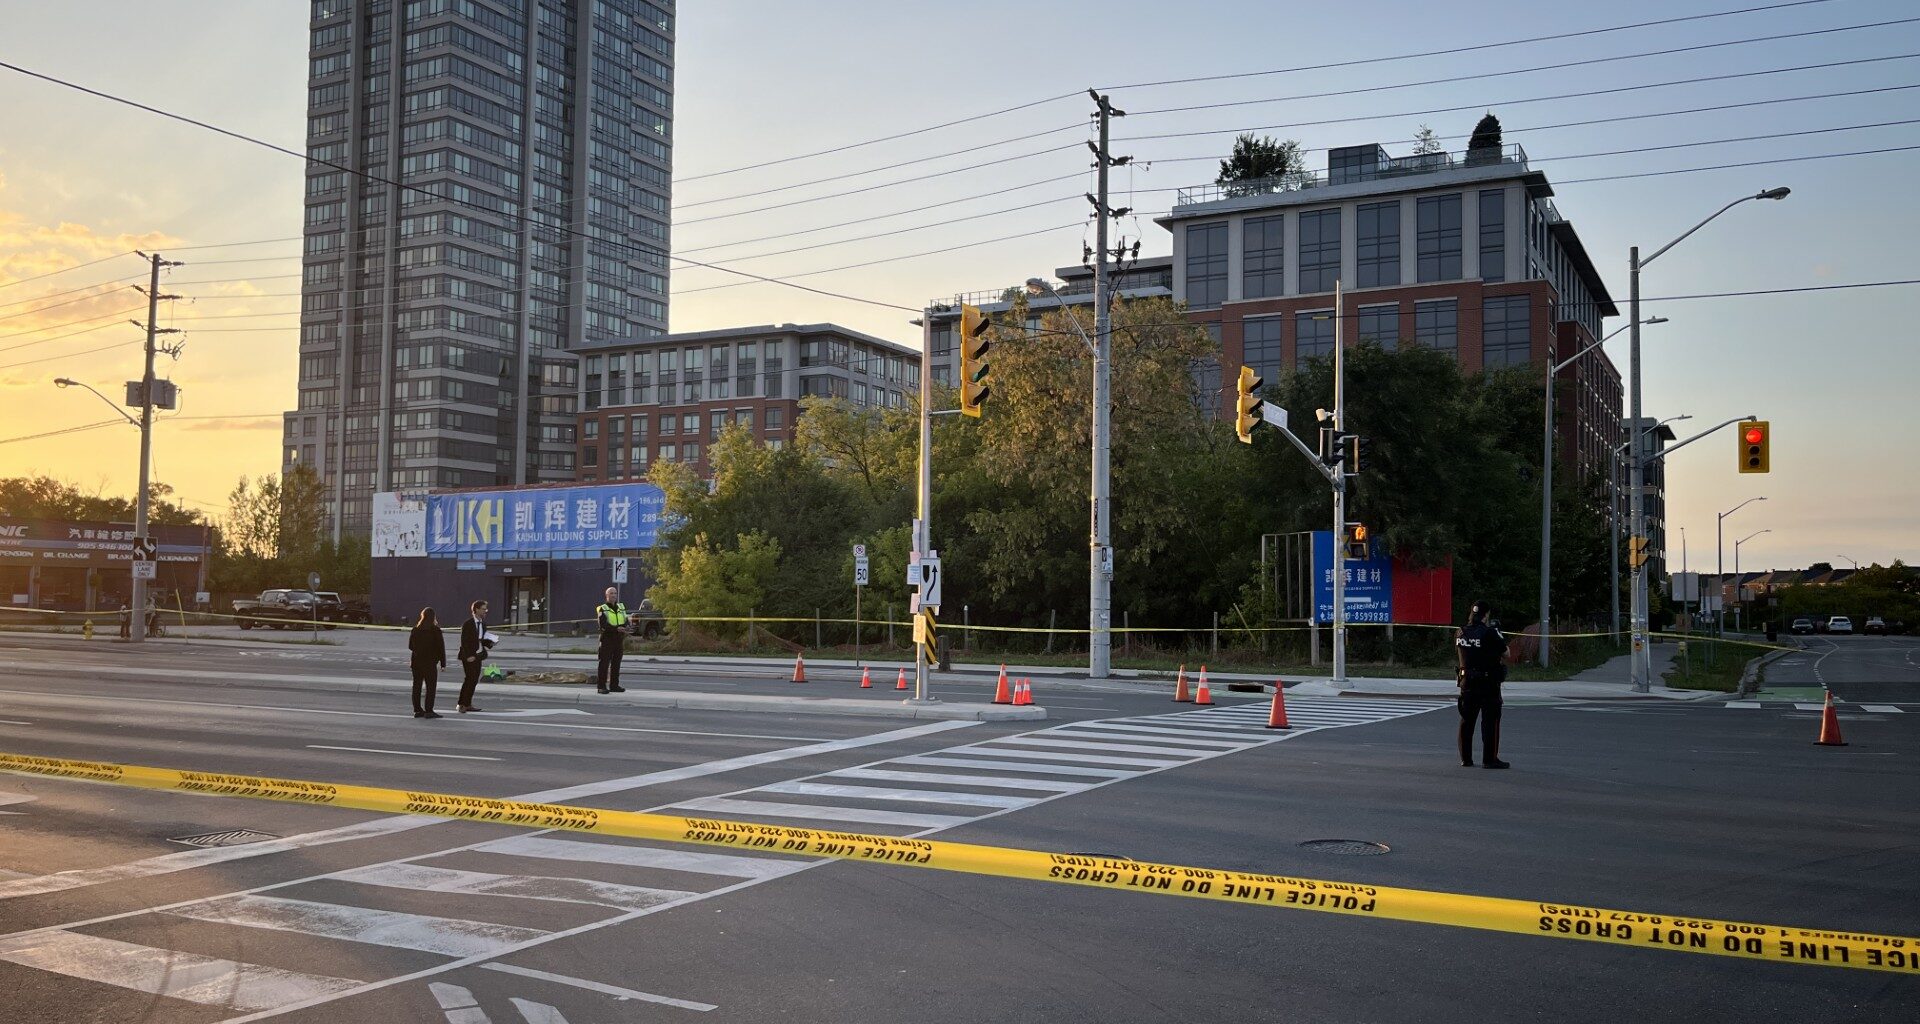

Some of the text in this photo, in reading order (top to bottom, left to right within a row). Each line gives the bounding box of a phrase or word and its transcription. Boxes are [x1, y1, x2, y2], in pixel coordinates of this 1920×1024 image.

[515, 496, 631, 530] 凯辉建材
[515, 529, 629, 543] KAIHUI BUILDING SUPPLIES
[857, 568, 867, 581] 50
[405, 803, 597, 829] POLICE LINE DO NOT CROSS
[686, 818, 932, 851] Crime Stoppers 1-800-222-8477 (TIPS)
[683, 830, 931, 863] POLICE LINE DO NOT CROSS
[1050, 854, 1376, 896] Crime Stoppers 1-800-222-8477 (TIPS)
[1049, 865, 1376, 912] POLICE LINE DO NOT CROSS
[1539, 904, 1601, 919] (TIPS)
[1538, 916, 1632, 940] CROSS
[1648, 927, 1707, 948] NOT
[1800, 931, 1905, 948] Stoppers
[1723, 935, 1762, 955] DO
[1780, 940, 1849, 963] LINE
